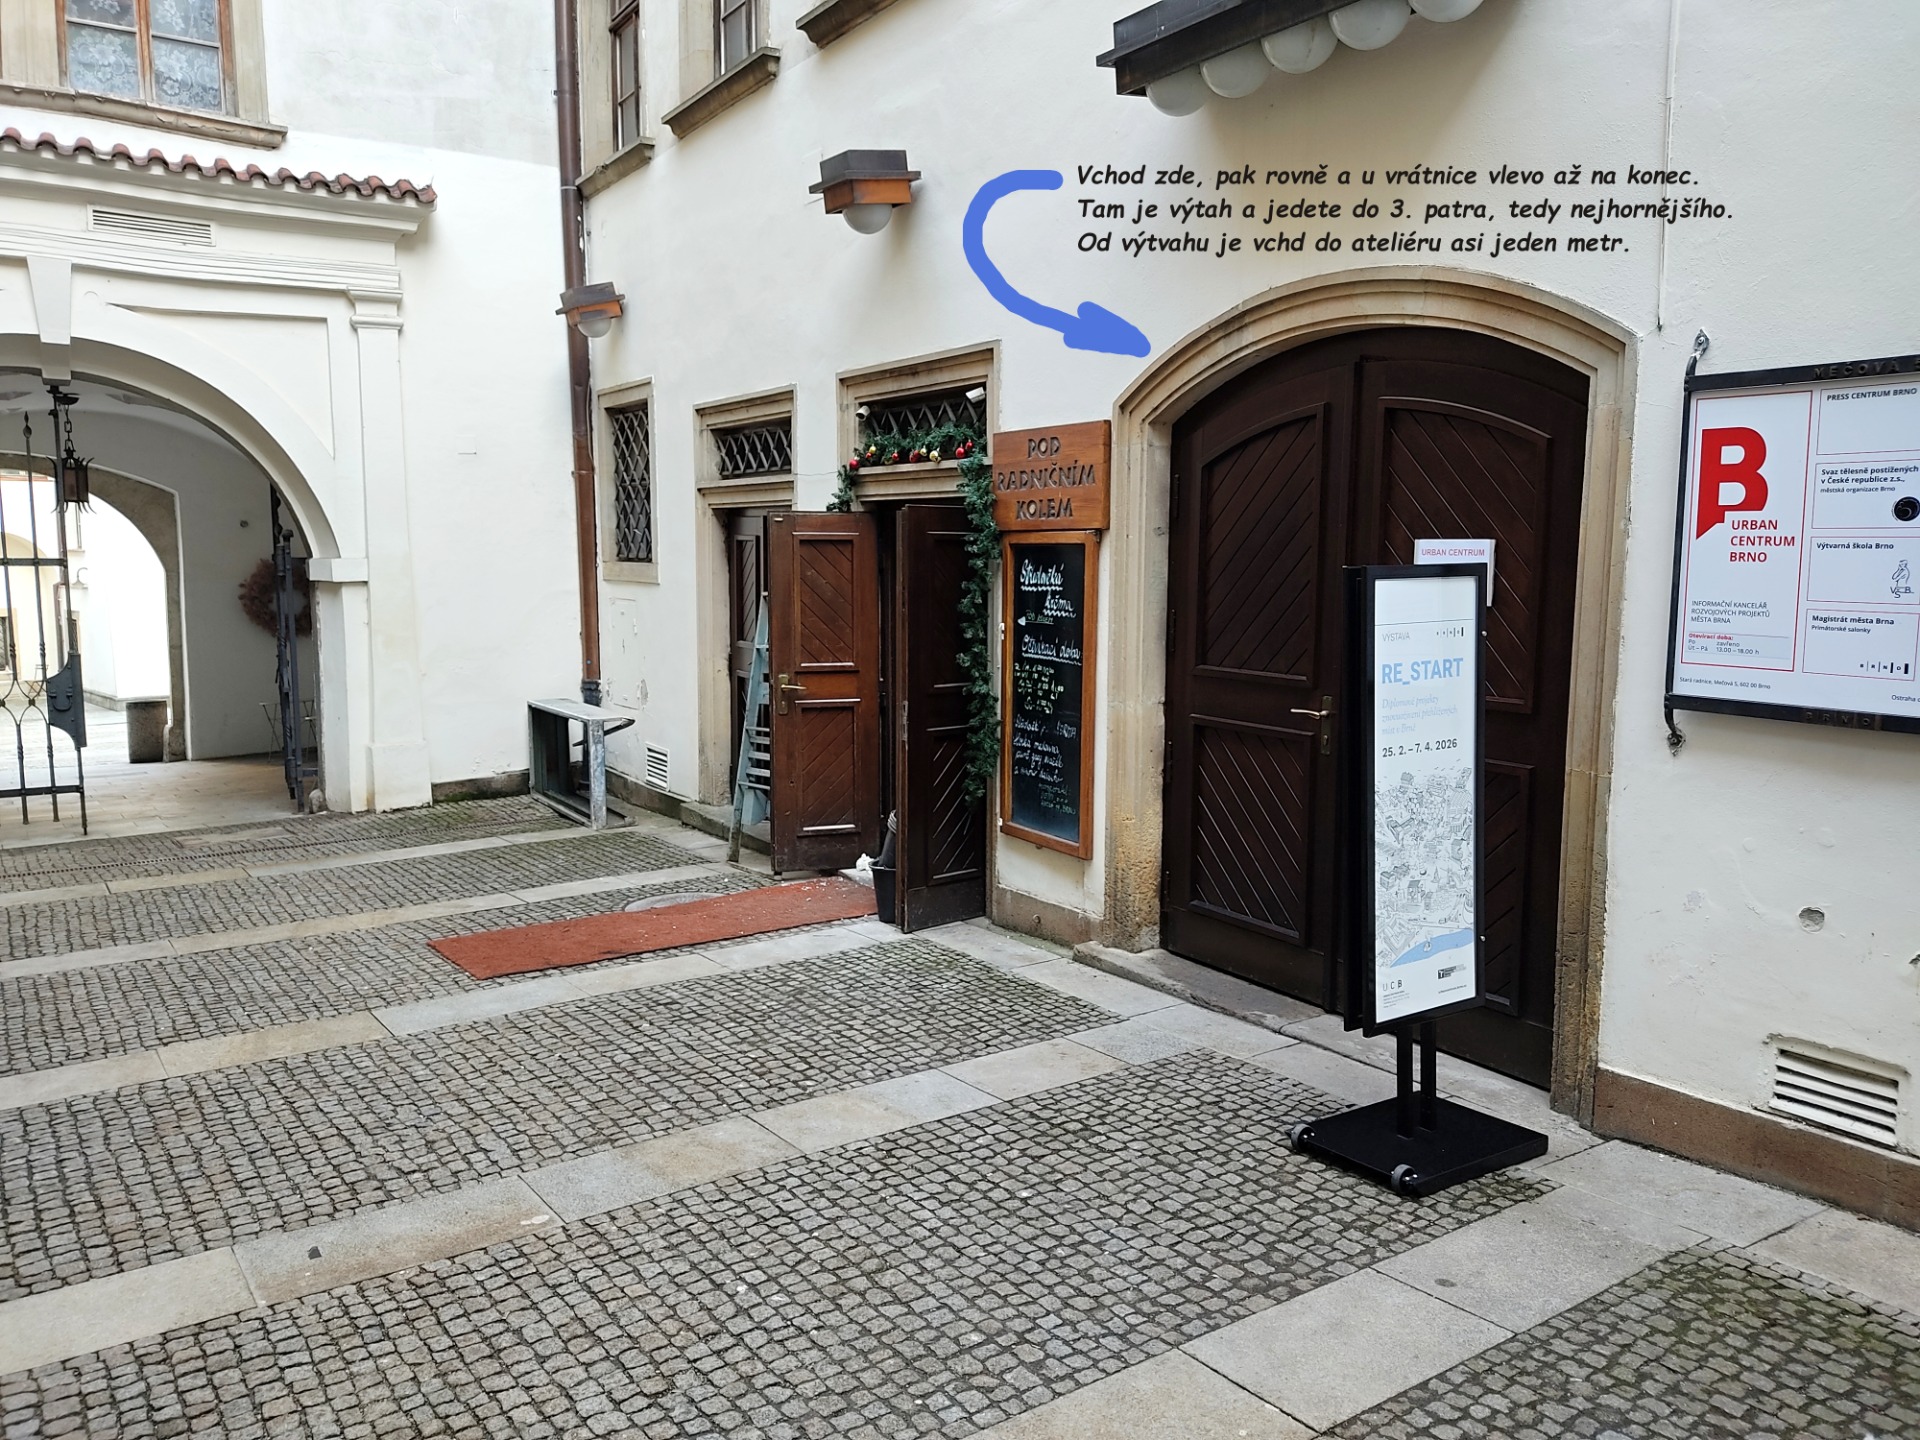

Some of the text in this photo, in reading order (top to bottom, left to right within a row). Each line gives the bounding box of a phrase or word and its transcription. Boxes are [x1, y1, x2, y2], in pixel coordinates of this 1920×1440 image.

[1826, 387, 1918, 401] PRESS CENTRUM BRNO
[1027, 436, 1061, 460] POD
[997, 460, 1096, 492] RADNIČNÍM
[1821, 464, 1919, 476] Svaz tělesně postižených
[1827, 476, 1850, 485] České
[1851, 475, 1888, 485] republice
[1820, 485, 1896, 494] městská organizace Brno
[1016, 498, 1073, 520] KOLEM
[1731, 518, 1778, 531] URBAN
[1730, 535, 1796, 547] CENTRUM
[1816, 541, 1895, 551] Výtvarná škola Brno
[1421, 548, 1485, 557] URBAN CENTRUM
[1729, 551, 1768, 563] BRNO
[1691, 600, 1768, 610] INFORMAČNÍ KANCELÁŘ
[1691, 608, 1771, 618] ROZVOJOVÝCH PROJEKTŮ
[1690, 615, 1732, 624] MĚSTA BRNA
[1812, 614, 1895, 626] Magistrát města Brna
[1811, 625, 1872, 634] Primátorské salonky
[1382, 630, 1411, 642] VÝSTAVA
[1381, 657, 1464, 685] RE_START
[1891, 694, 1916, 703] Ostraha
[1382, 746, 1396, 758] 25.
[1424, 741, 1433, 751] 4.
[1435, 738, 1458, 751] 2026
